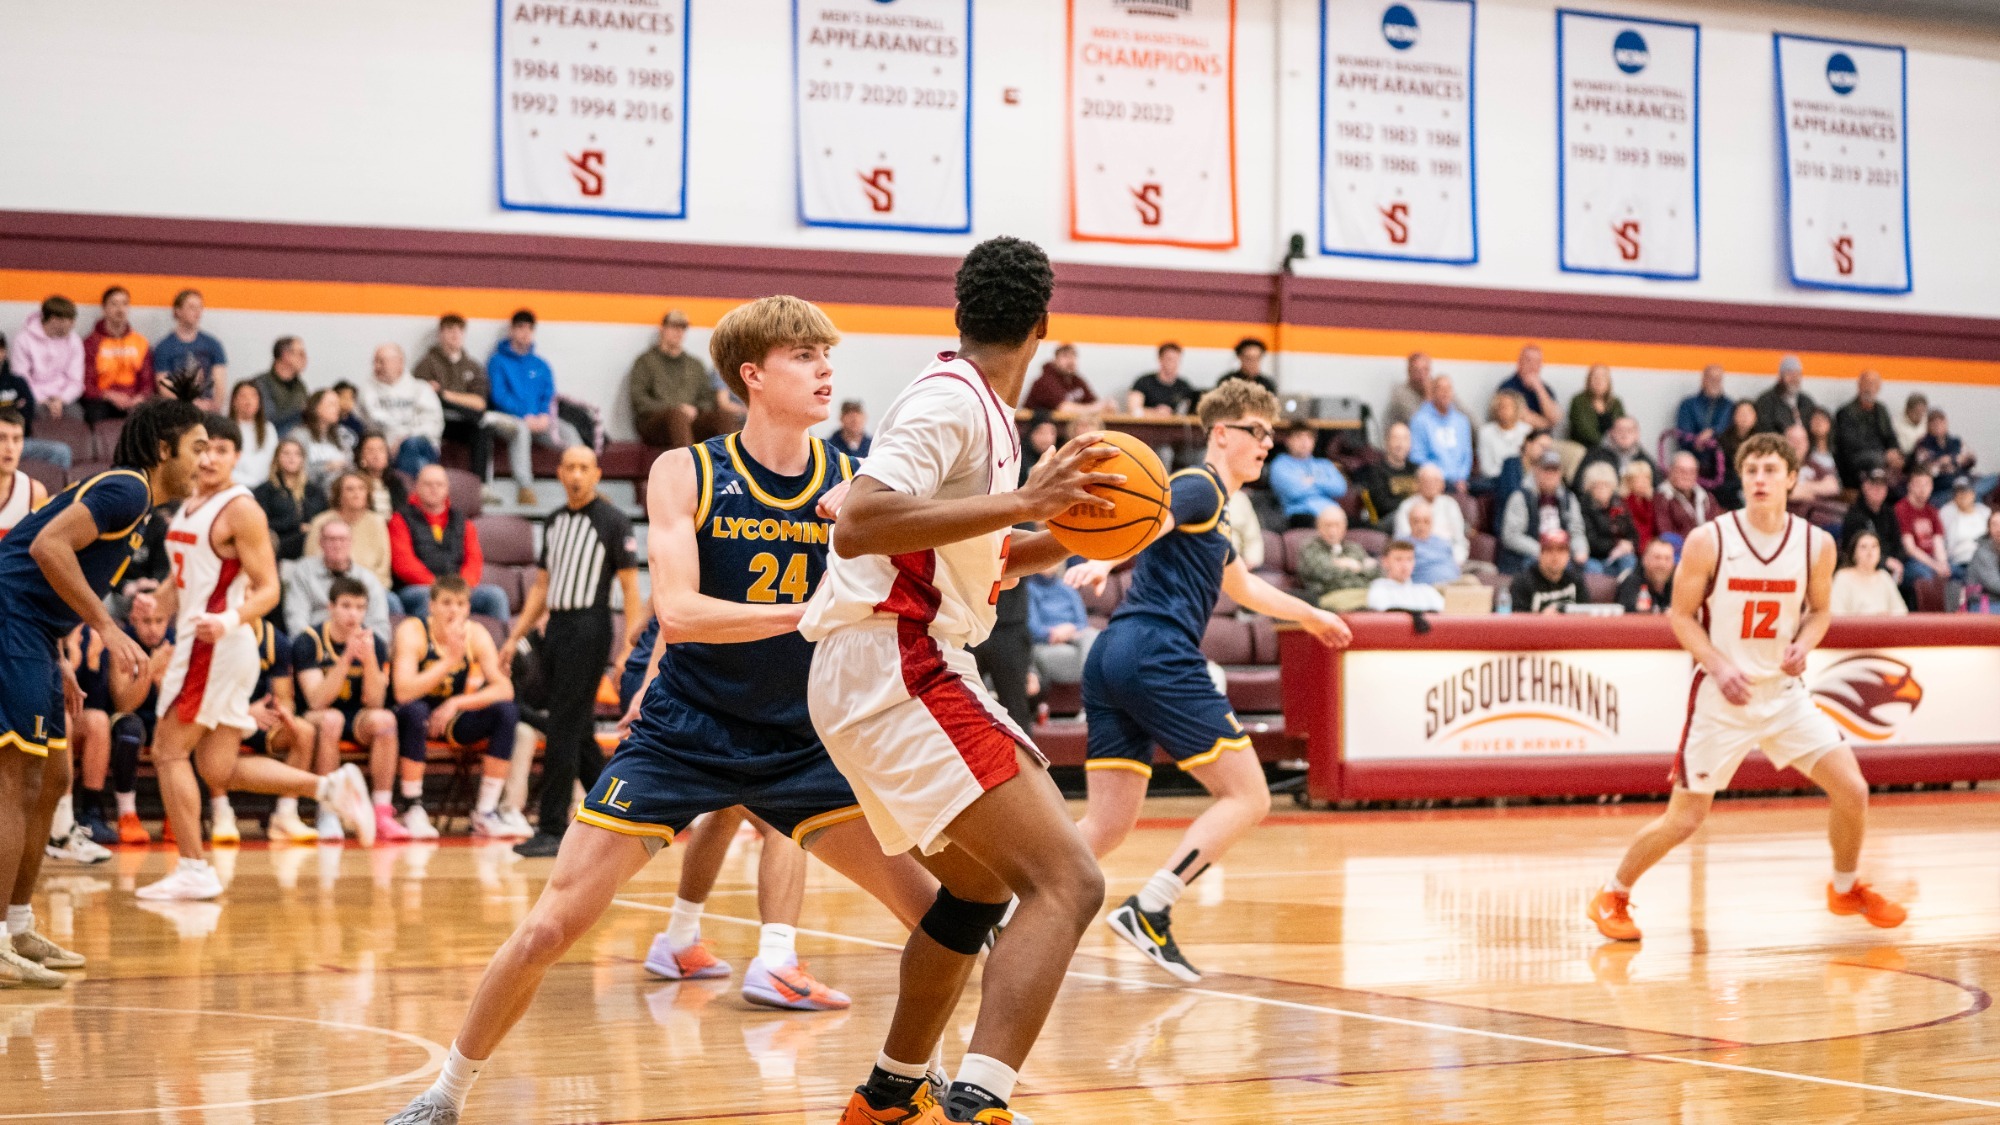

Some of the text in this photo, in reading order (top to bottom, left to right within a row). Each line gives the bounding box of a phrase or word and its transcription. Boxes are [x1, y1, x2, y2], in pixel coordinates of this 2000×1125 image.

[515, 3, 675, 35] APPEARANCES
[865, 13, 944, 31] BASKETBALL
[808, 27, 959, 58] APPEARANCES
[513, 58, 675, 89] 1984 1986 1989
[1082, 43, 1223, 76] CHAMPIONS
[807, 80, 959, 110] 2017 2020 2022
[1336, 71, 1464, 102] APPEARANCES
[512, 92, 673, 123] 1992 1994 2016
[1081, 97, 1174, 124] 2020 2022
[1572, 95, 1687, 124] APPEARANCES
[1792, 114, 1897, 143] APPEARANCES
[746, 552, 809, 603] 24
[1740, 600, 1780, 639] 12
[1425, 654, 1620, 741] SUSQUEHANNA
[1460, 735, 1587, 752] RIVER HAWKS
